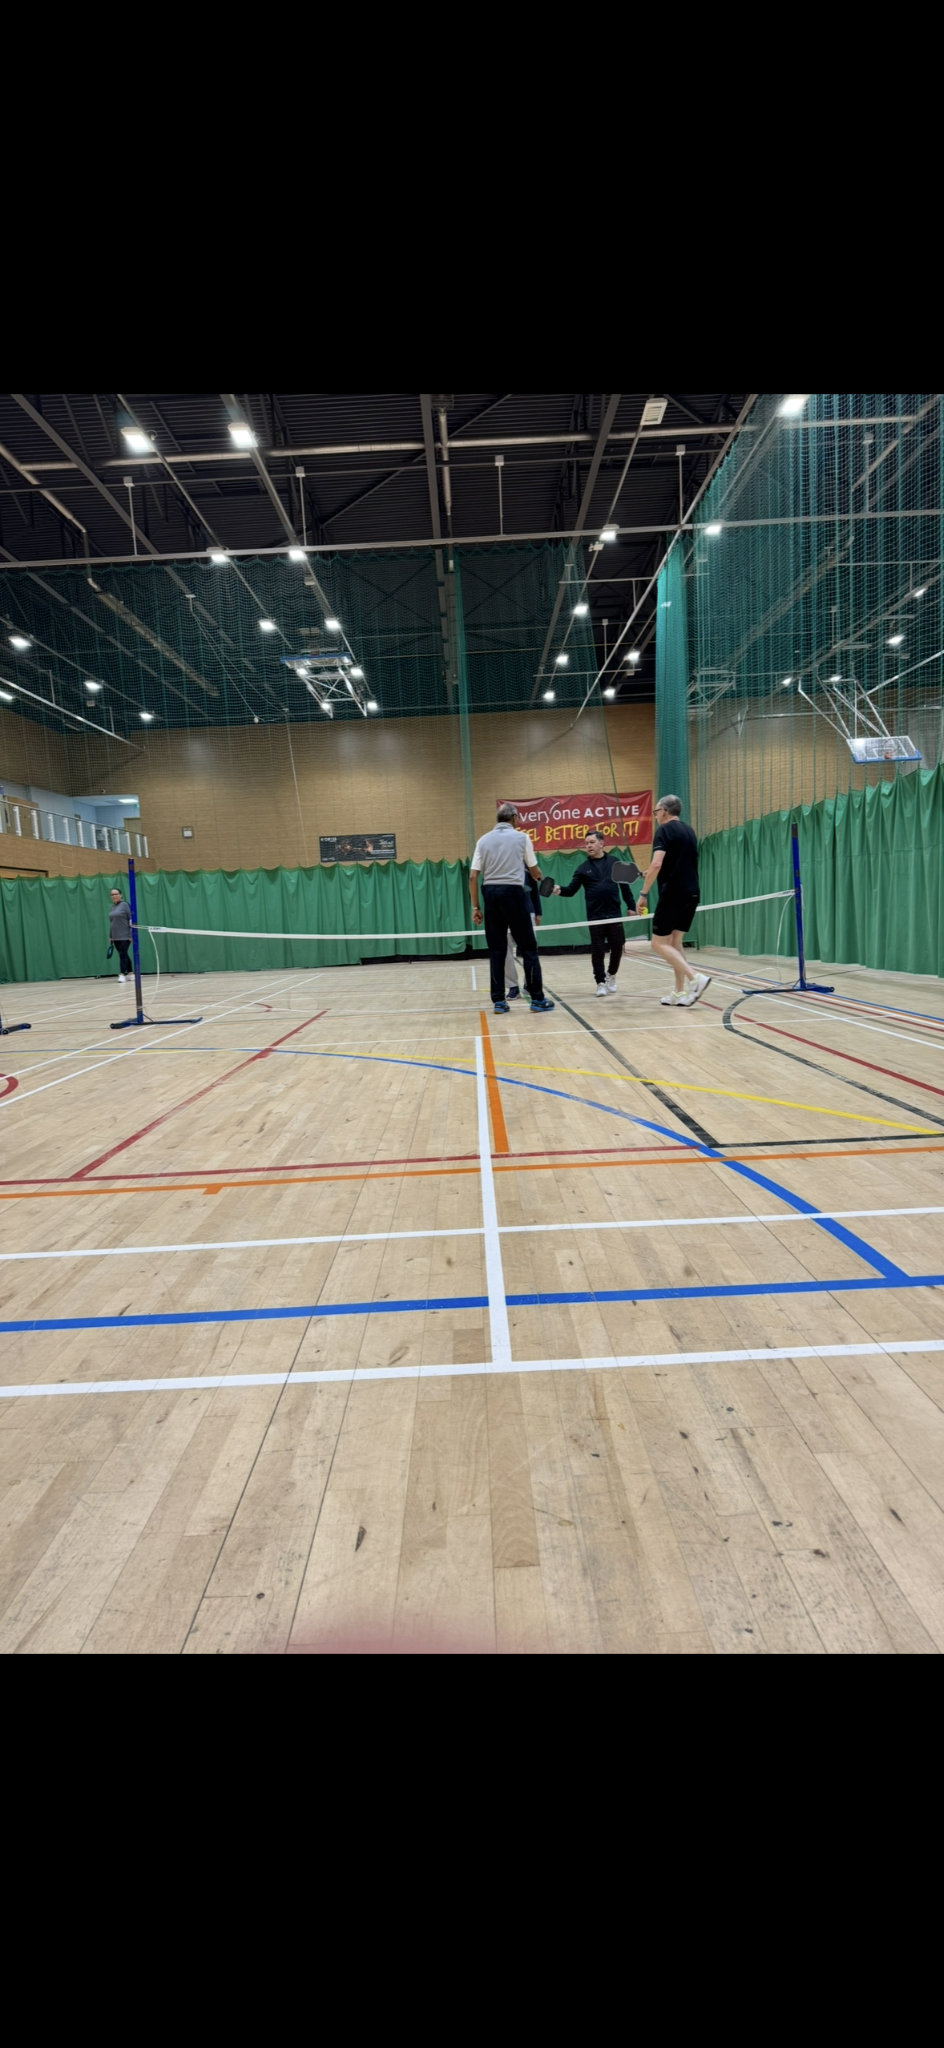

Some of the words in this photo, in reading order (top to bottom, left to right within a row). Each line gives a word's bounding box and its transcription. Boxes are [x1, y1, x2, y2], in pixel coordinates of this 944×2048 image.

[518, 802, 581, 824] veryone
[583, 804, 640, 818] ACTIVE
[515, 827, 540, 842] EL
[544, 823, 590, 844] BETTER
[623, 820, 639, 837] IT!
